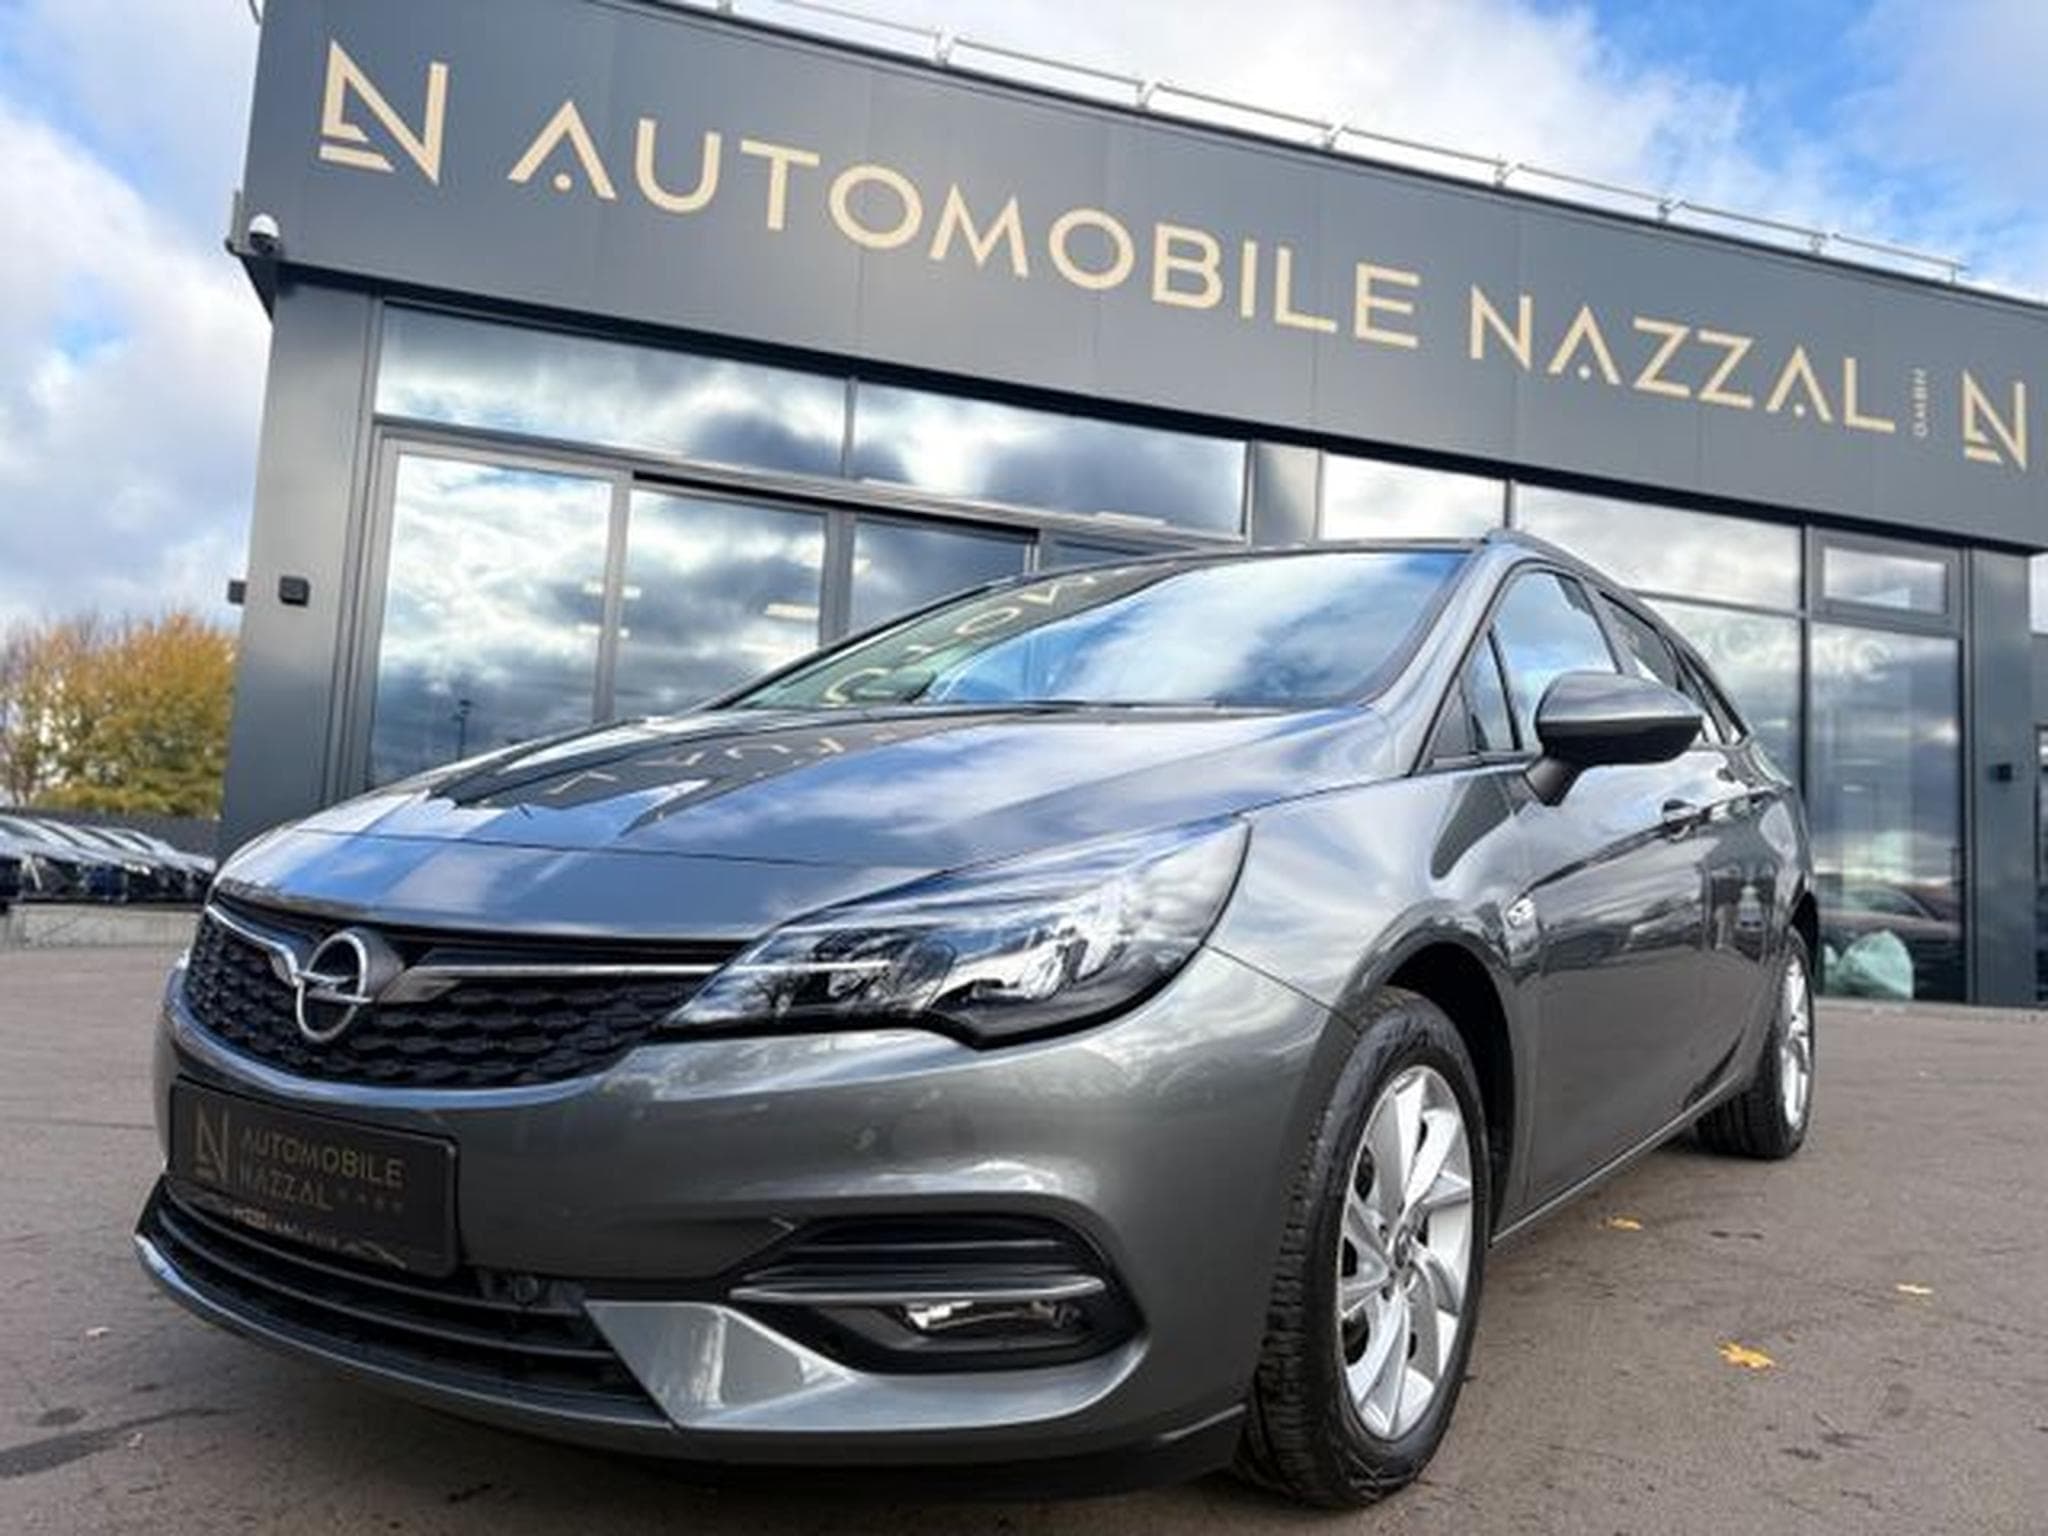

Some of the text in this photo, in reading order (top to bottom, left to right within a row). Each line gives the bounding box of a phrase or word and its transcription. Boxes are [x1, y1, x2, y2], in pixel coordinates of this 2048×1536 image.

[507, 100, 1420, 349] AUTOMOBILE
[1470, 284, 1896, 434] NAZZAL
[238, 1157, 334, 1210] NAZZAL
[241, 1125, 405, 1188] AUTOMOBILE
